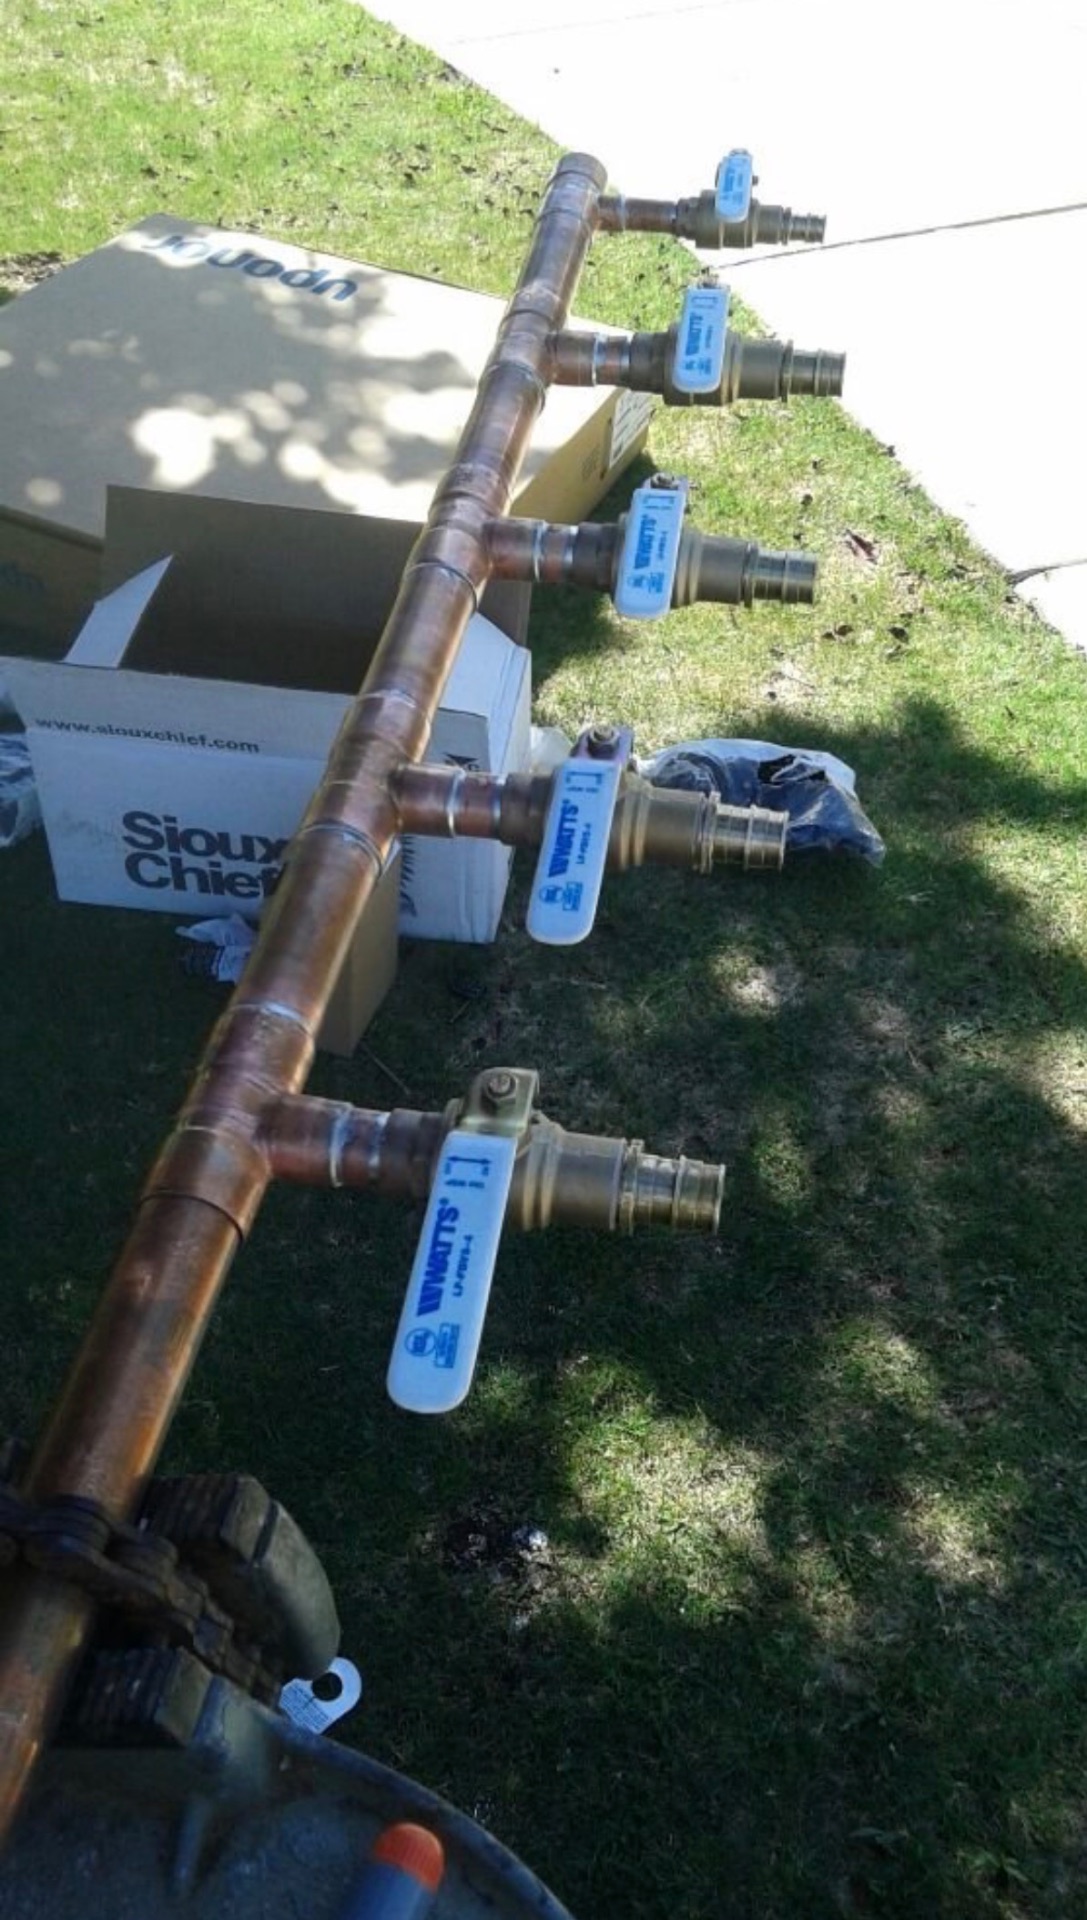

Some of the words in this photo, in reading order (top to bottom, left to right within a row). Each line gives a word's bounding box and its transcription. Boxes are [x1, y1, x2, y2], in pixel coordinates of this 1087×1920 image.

[141, 236, 358, 301] uponor
[35, 718, 260, 753] www.siouxchief.com
[122, 810, 289, 865] Sioux
[548, 803, 580, 877] WATTS
[124, 851, 283, 899] Chief
[416, 1204, 460, 1318] WATTS
